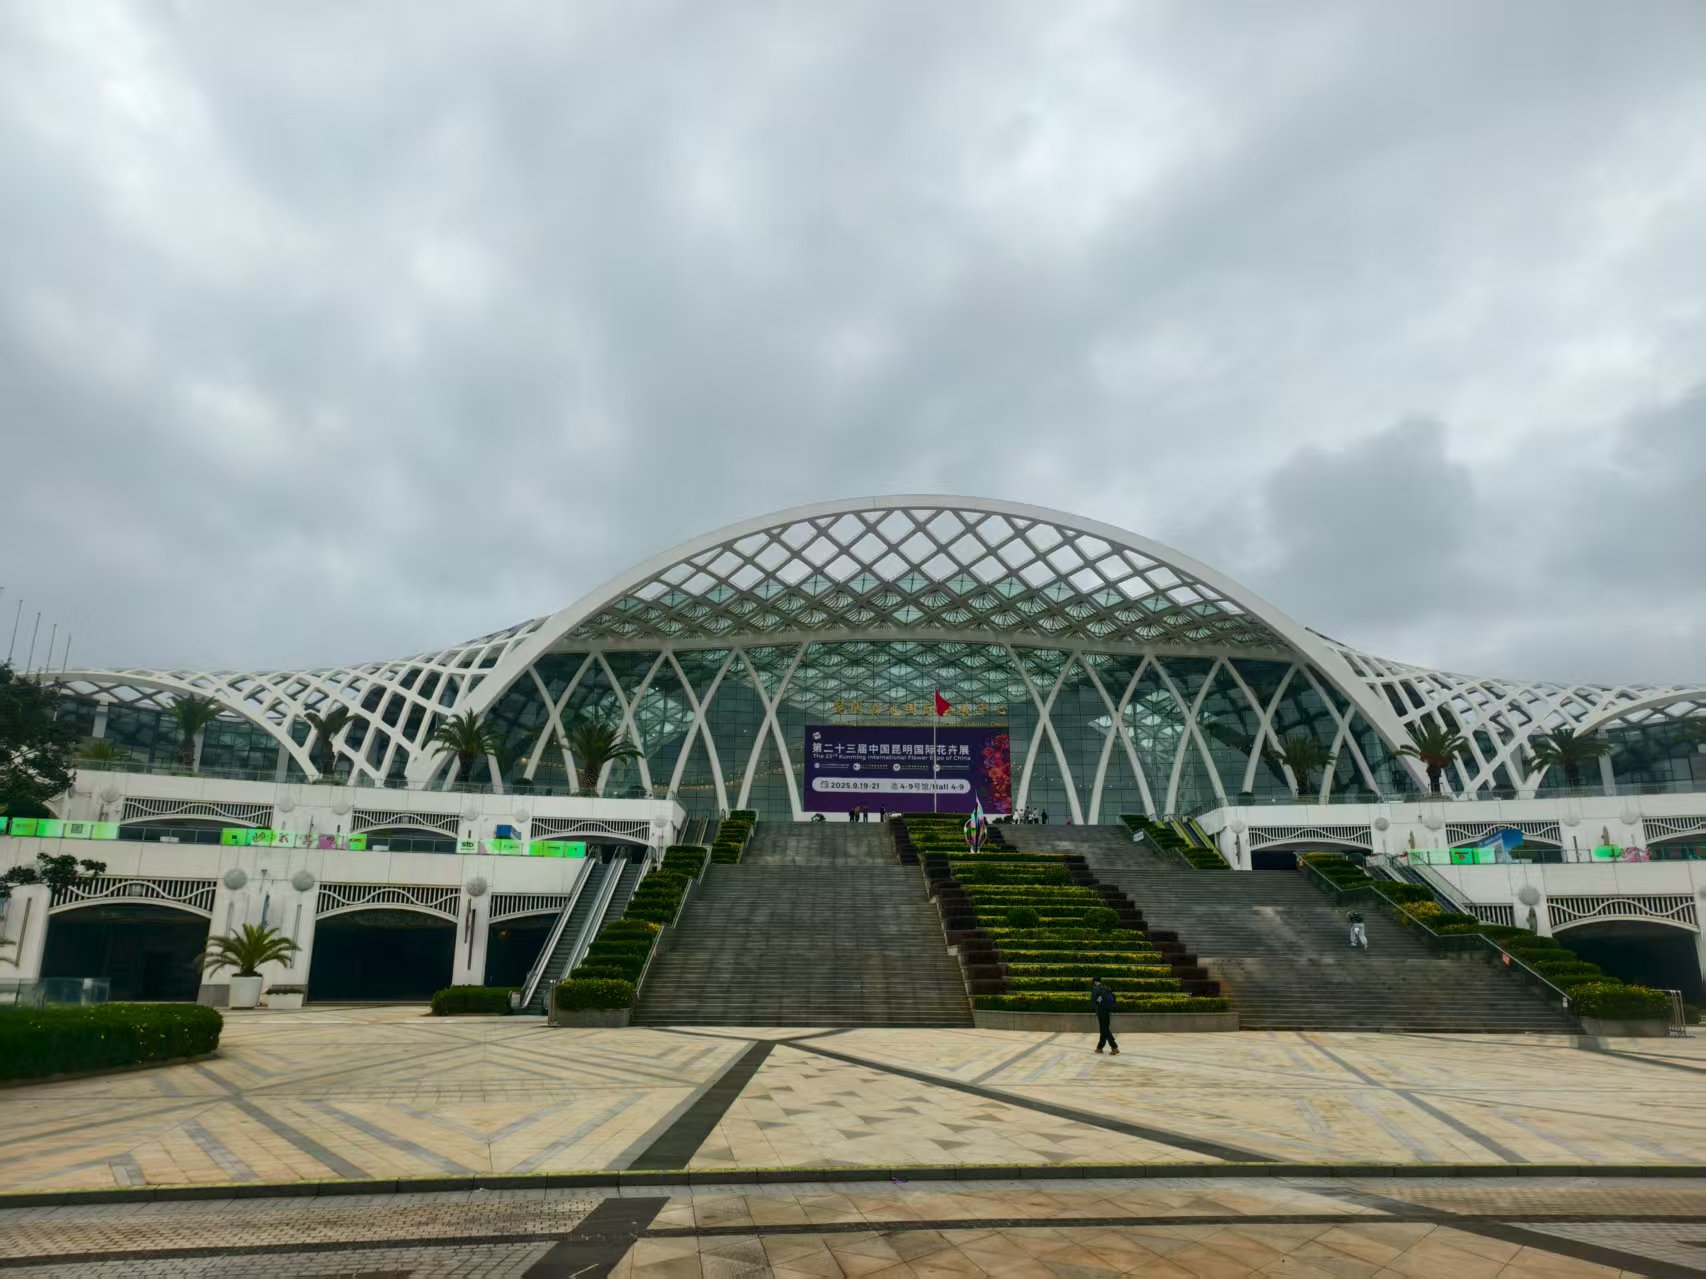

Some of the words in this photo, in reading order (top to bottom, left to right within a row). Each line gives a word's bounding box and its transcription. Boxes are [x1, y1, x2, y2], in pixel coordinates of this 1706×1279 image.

[812, 742, 969, 755] 第二十三届中国昆明国际花卉展
[831, 782, 880, 790] 2025.9.19-21
